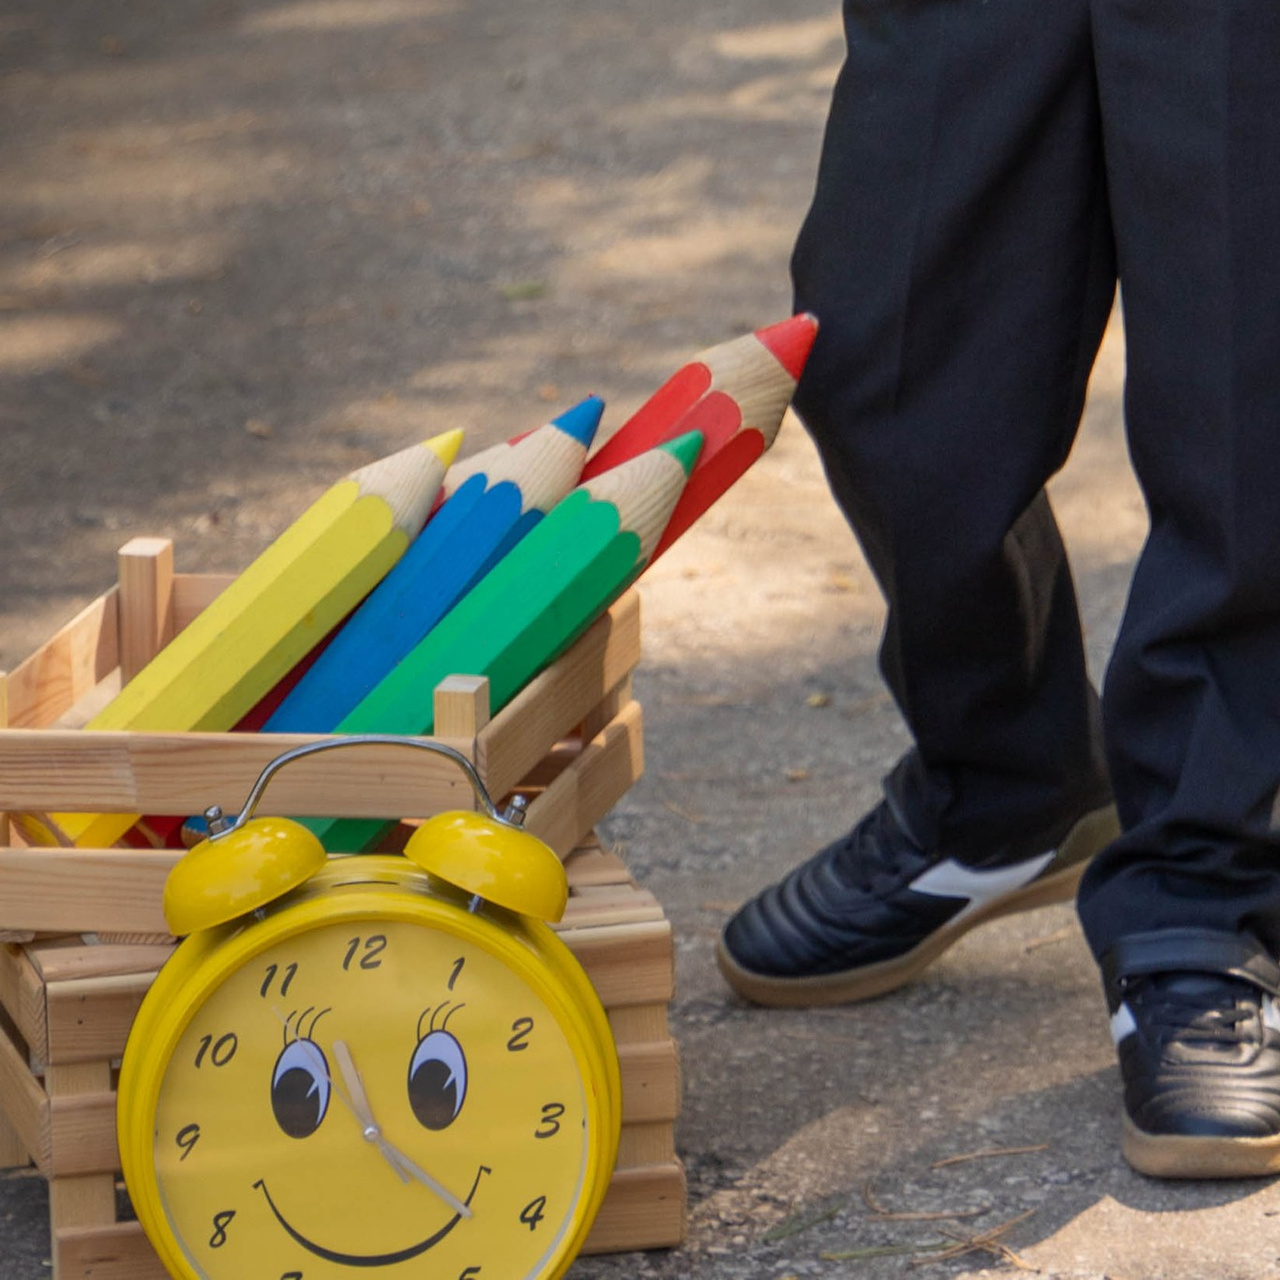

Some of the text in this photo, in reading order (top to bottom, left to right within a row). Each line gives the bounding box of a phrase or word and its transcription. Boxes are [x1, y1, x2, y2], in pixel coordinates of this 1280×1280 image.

[342, 934, 388, 971] 12
[259, 962, 299, 998] 11
[448, 956, 466, 990] 1
[194, 1032, 238, 1069] 10
[506, 1017, 534, 1052] 2
[534, 1102, 566, 1139] 3
[175, 1123, 201, 1161] 9
[208, 1210, 237, 1249] 8
[519, 1195, 547, 1232] 4
